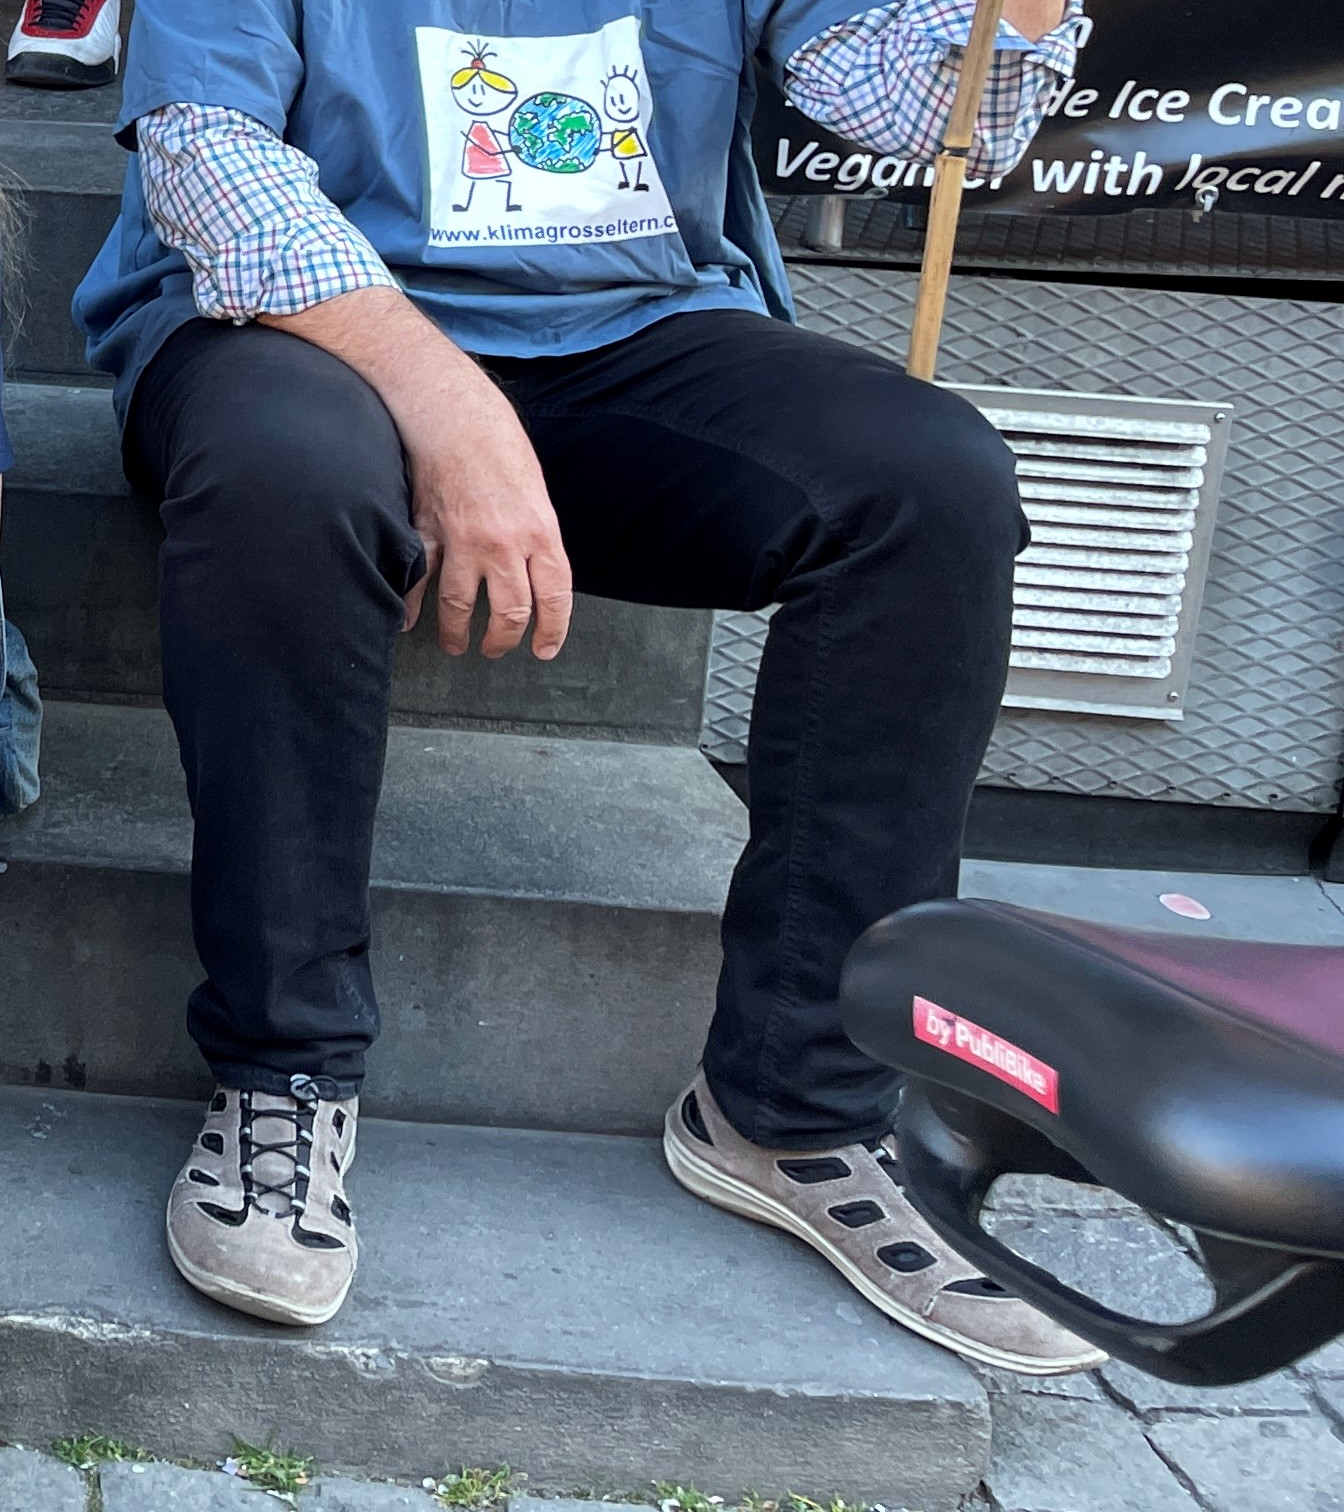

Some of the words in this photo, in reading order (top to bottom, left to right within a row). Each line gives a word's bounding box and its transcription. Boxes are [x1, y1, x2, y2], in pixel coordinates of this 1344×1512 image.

[1108, 79, 1191, 123] Ice
[1207, 82, 1342, 131] Crea
[1031, 149, 1164, 196] with
[1175, 152, 1323, 197] local
[430, 215, 674, 244] www.klimagrosseltern.c
[925, 1007, 953, 1046] by
[954, 1021, 1048, 1096] PubliBike
